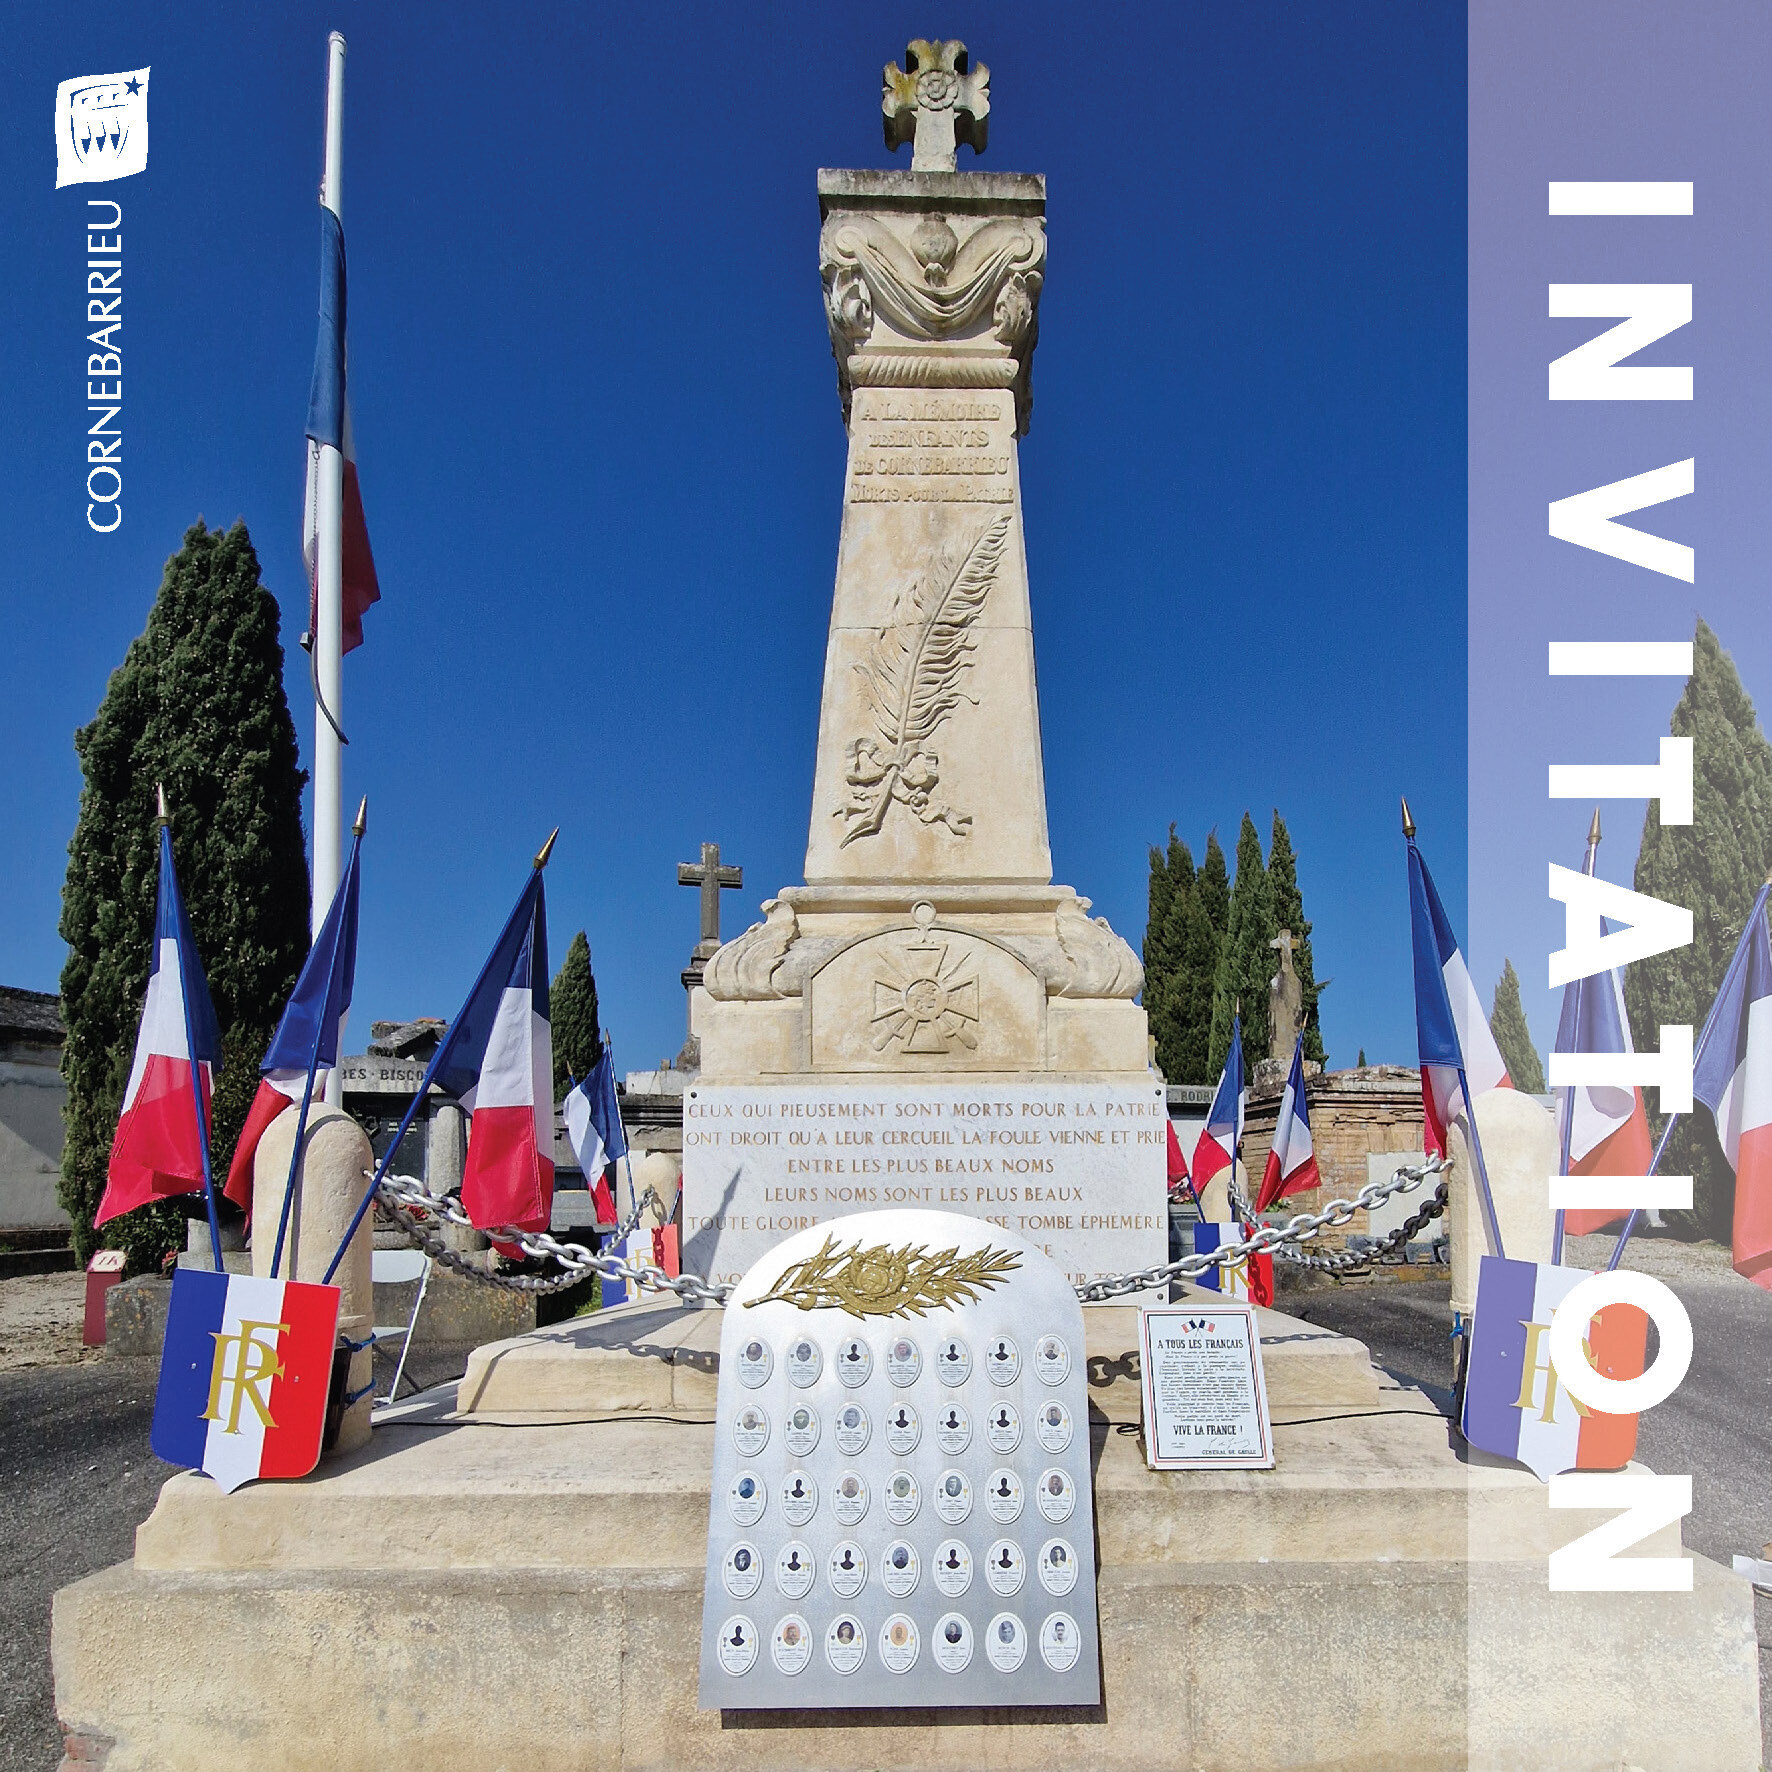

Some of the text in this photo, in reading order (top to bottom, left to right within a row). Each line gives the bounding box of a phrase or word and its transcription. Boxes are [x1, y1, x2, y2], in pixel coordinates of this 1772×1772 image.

[893, 429, 990, 448] ENFANTS
[877, 456, 1011, 475] CORNEBARRIEU
[850, 484, 900, 503] MORTS
[380, 1069, 424, 1081] BISCO
[688, 1102, 1160, 1118] CEUX QUI PIEUSEMENT SONT MORTS POUR LA PATRIE
[686, 1130, 722, 1146] ONT
[731, 1130, 782, 1146] DROIT
[835, 1130, 875, 1146] LEUR
[882, 1130, 954, 1146] CERCUEIL
[962, 1130, 982, 1146] LA
[990, 1130, 1042, 1146] FOULE
[1049, 1130, 1105, 1146] VIENNE
[1111, 1130, 1130, 1146] ET
[1137, 1130, 1165, 1146] PRIE
[788, 1159, 1055, 1174] ENTRE LES PLUS BEAUX NOMS
[765, 1187, 1083, 1202] LEURS NOMS SONT LES PLUS BEAUX
[688, 1216, 749, 1231] TOUTE
[1017, 1215, 1073, 1230] TOMBE
[1157, 1339, 1244, 1350] A TOUS LES FRANÇAIS
[196, 1318, 291, 1436] RF
[1173, 1425, 1192, 1436] VIVE
[1194, 1425, 1205, 1435] LA
[1206, 1425, 1237, 1436] FRANCE
